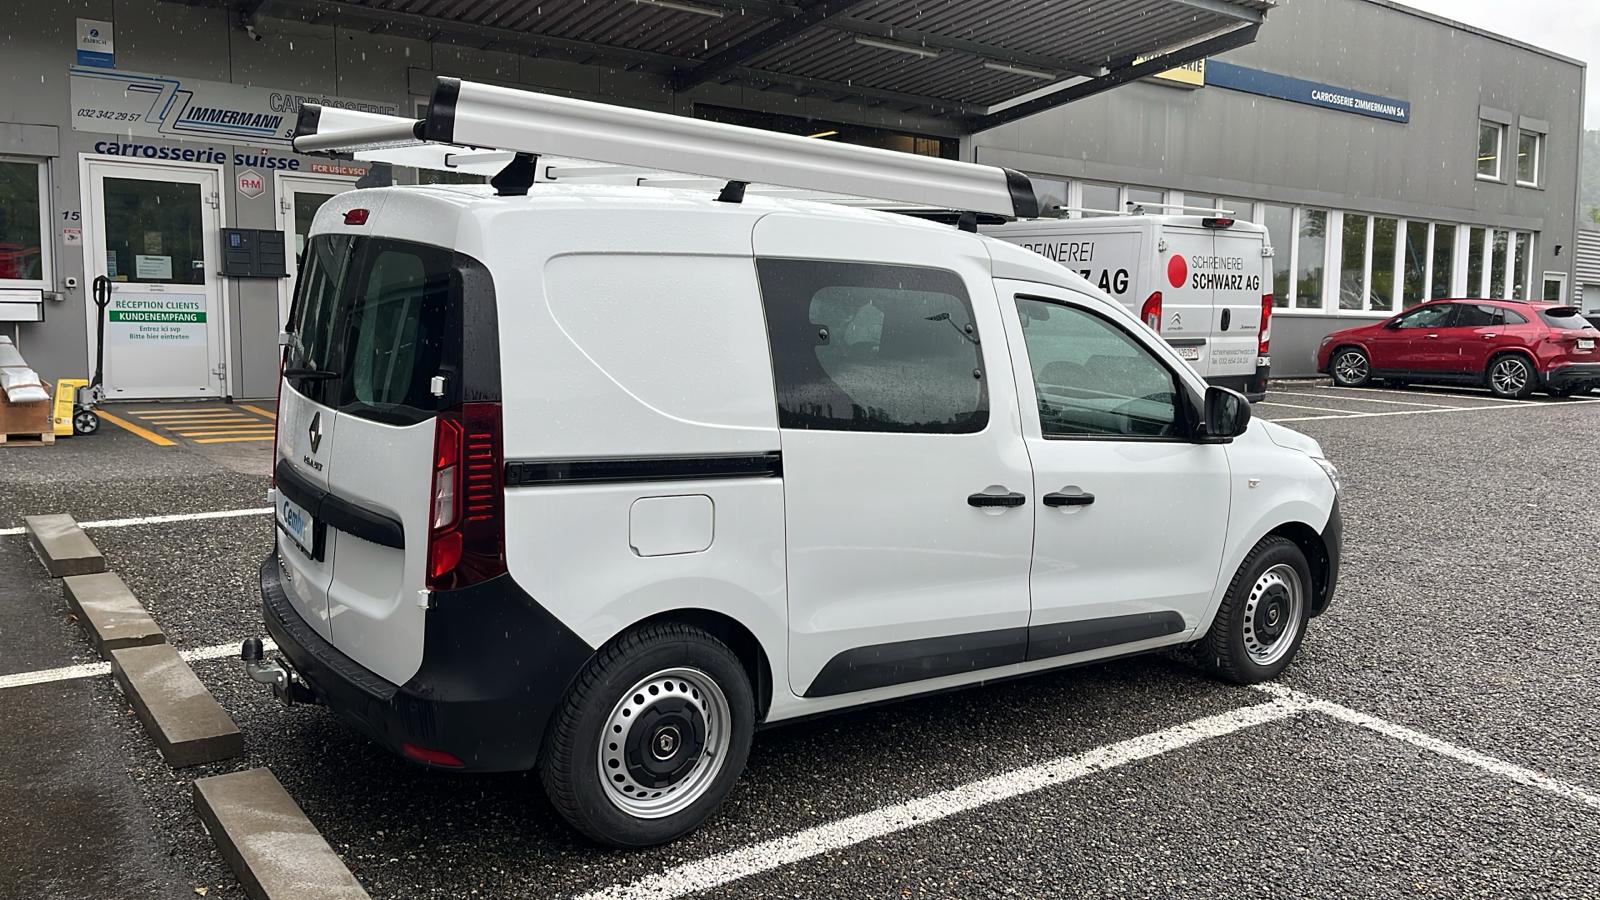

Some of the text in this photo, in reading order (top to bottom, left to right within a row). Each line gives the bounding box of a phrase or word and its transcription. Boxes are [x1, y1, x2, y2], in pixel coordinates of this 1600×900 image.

[1311, 90, 1405, 117] CARROSSERIE ZIMMERMANN SA
[77, 108, 142, 122] 032 342 29 57
[94, 140, 300, 171] carrosserie suisse
[62, 210, 80, 221] 15
[1192, 256, 1243, 270] SCHREINEREI
[1098, 268, 1129, 295] AG
[1192, 273, 1260, 291] SCHWARZ AG
[115, 299, 200, 310] RÉCEPTION CLIENTS
[119, 312, 197, 322] KUNDENEMPFANG
